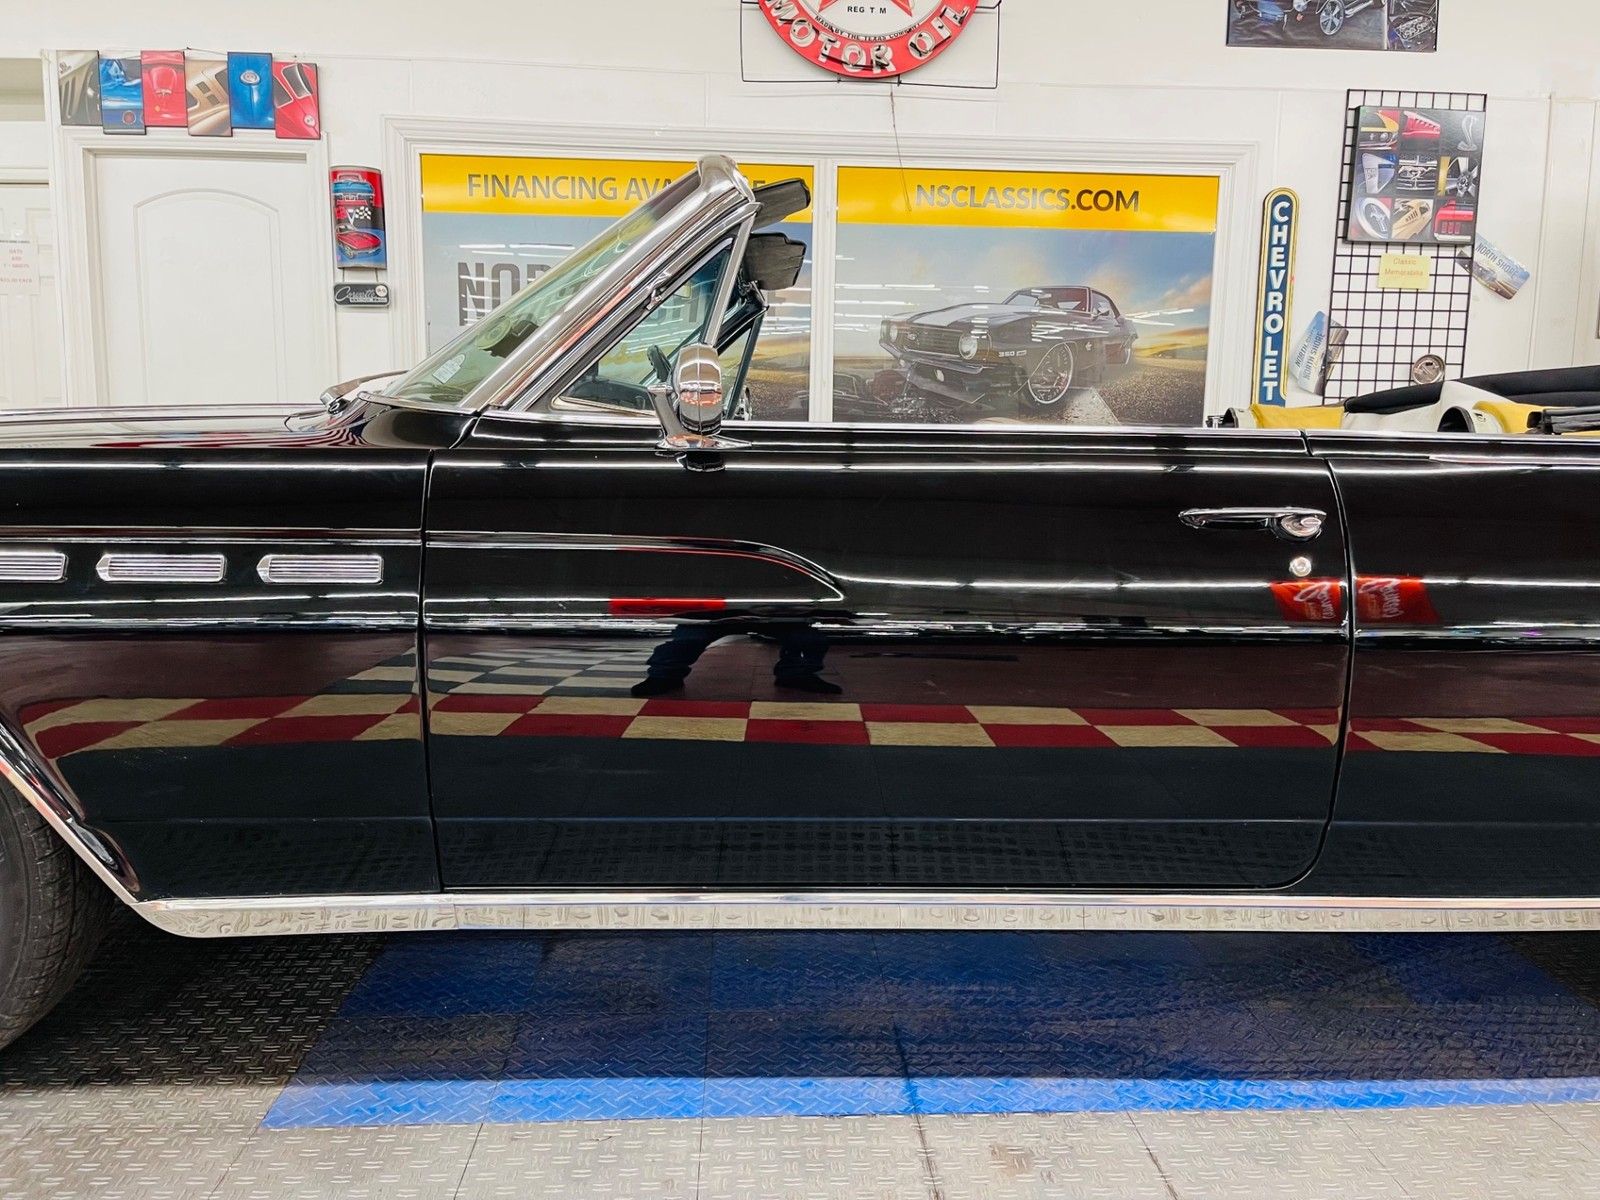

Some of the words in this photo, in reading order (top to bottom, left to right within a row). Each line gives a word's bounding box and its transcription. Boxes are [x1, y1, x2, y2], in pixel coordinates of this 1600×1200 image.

[763, 0, 897, 74] MOTOR
[908, 5, 970, 60] OIL
[847, 32, 860, 40] THE
[888, 23, 920, 39] COMPNY
[467, 174, 618, 200] FINANCING
[915, 184, 1139, 212] NSCLASSICS.COM
[1393, 257, 1417, 265] Classic
[1475, 242, 1498, 262] NORTH
[1496, 257, 1518, 279] SHORE
[1262, 201, 1290, 401] CHEVROLET
[1302, 356, 1315, 380] NORTH
[1311, 331, 1326, 356] SHORE
